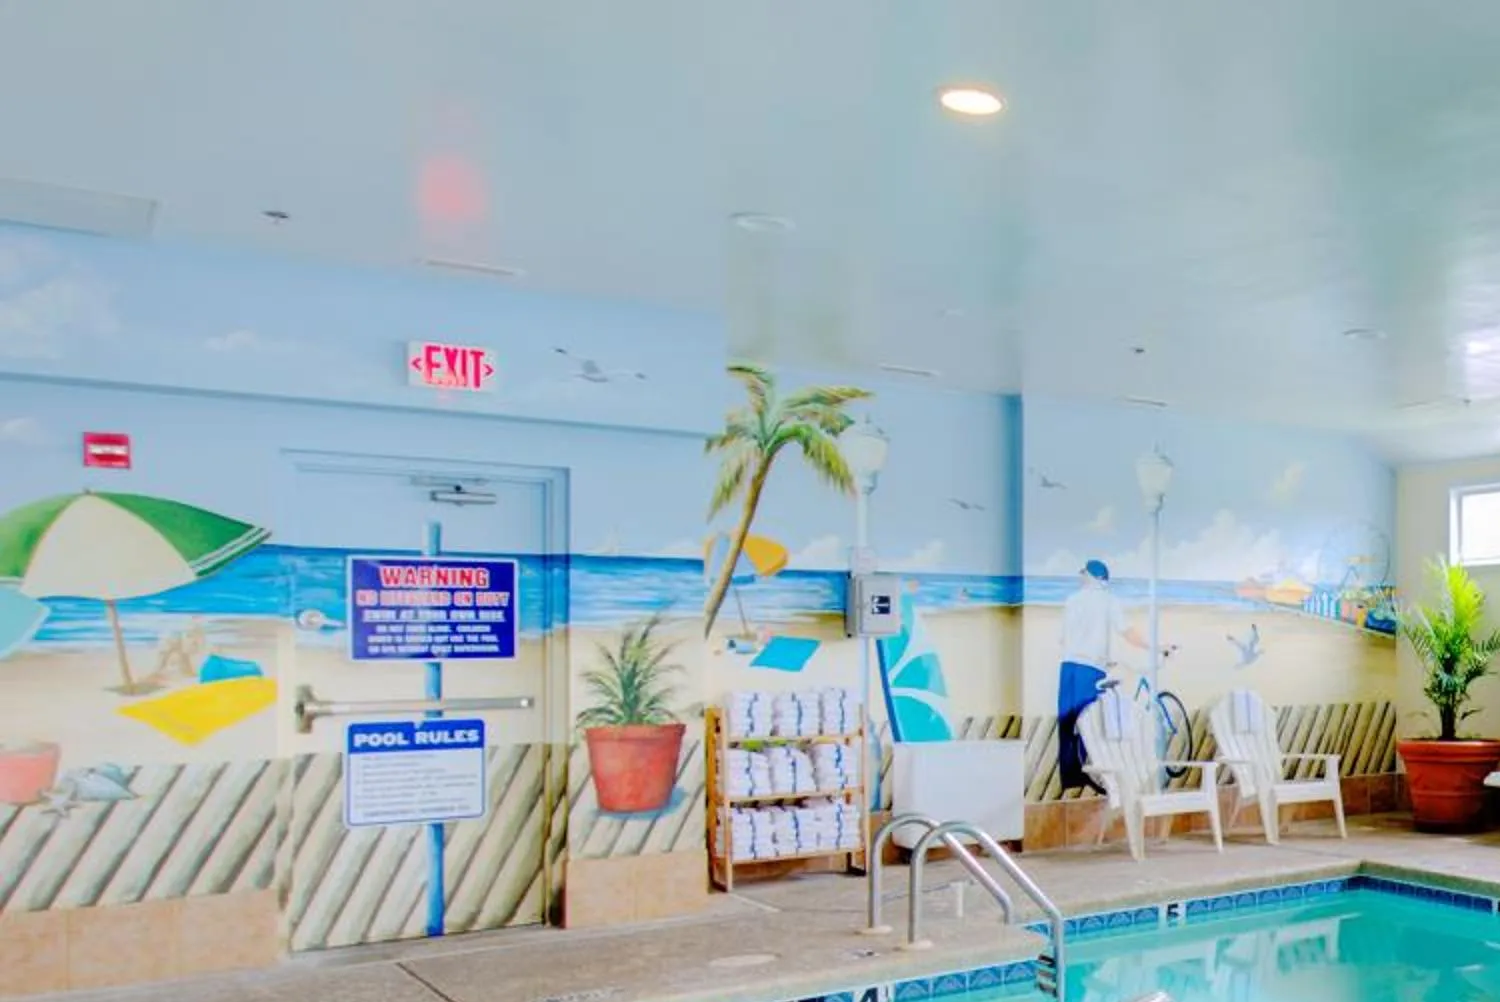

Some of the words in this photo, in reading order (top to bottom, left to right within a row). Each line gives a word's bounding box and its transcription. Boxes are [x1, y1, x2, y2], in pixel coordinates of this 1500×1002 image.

[424, 344, 485, 388] EXIT
[379, 565, 490, 589] WARNING
[353, 731, 410, 747] POOL
[415, 729, 479, 745] RULES
